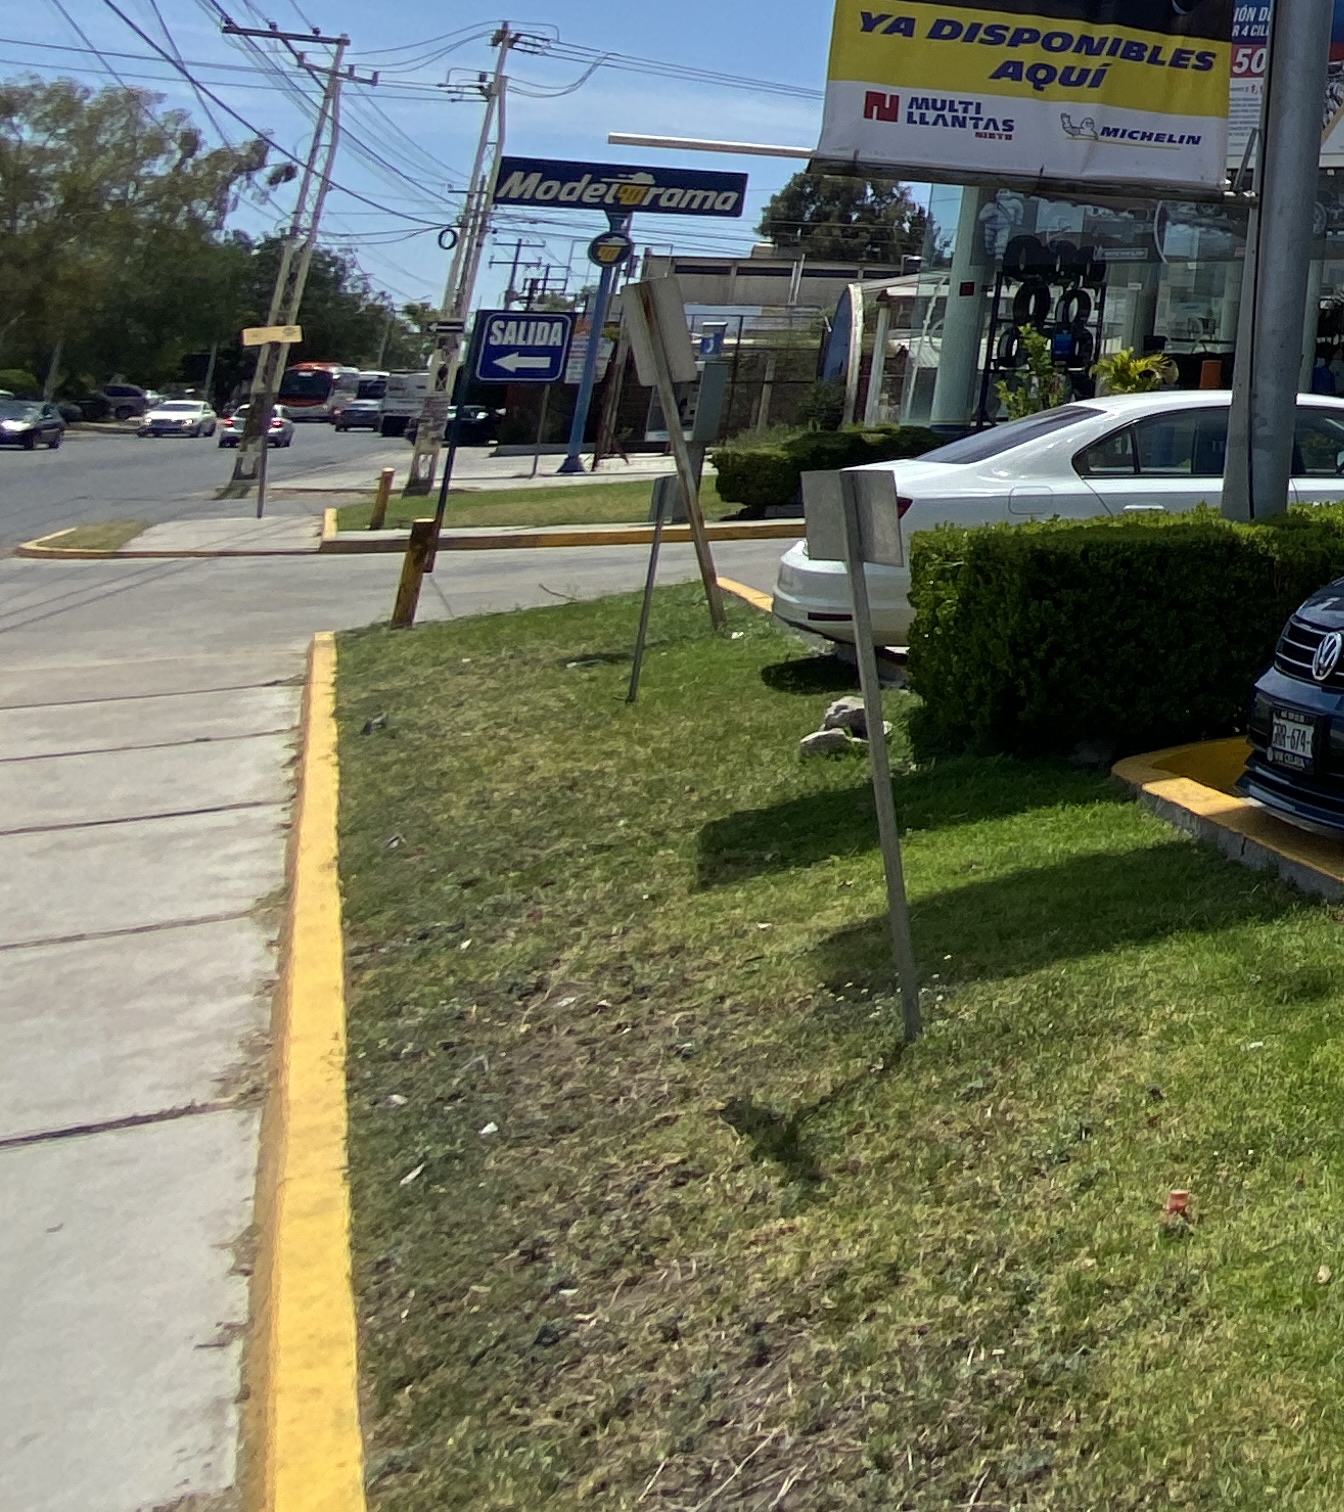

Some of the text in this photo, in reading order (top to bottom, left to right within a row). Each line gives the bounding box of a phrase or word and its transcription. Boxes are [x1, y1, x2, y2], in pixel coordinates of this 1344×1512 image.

[1233, 4, 1256, 22] IÓN
[858, 9, 1217, 73] YA DISPONIBLES
[989, 58, 1111, 90] AQUÍ
[908, 96, 983, 115] MULTI
[906, 111, 1015, 133] LLANTAS
[1100, 126, 1202, 146] MICHELIN
[489, 320, 563, 348] SALIDA
